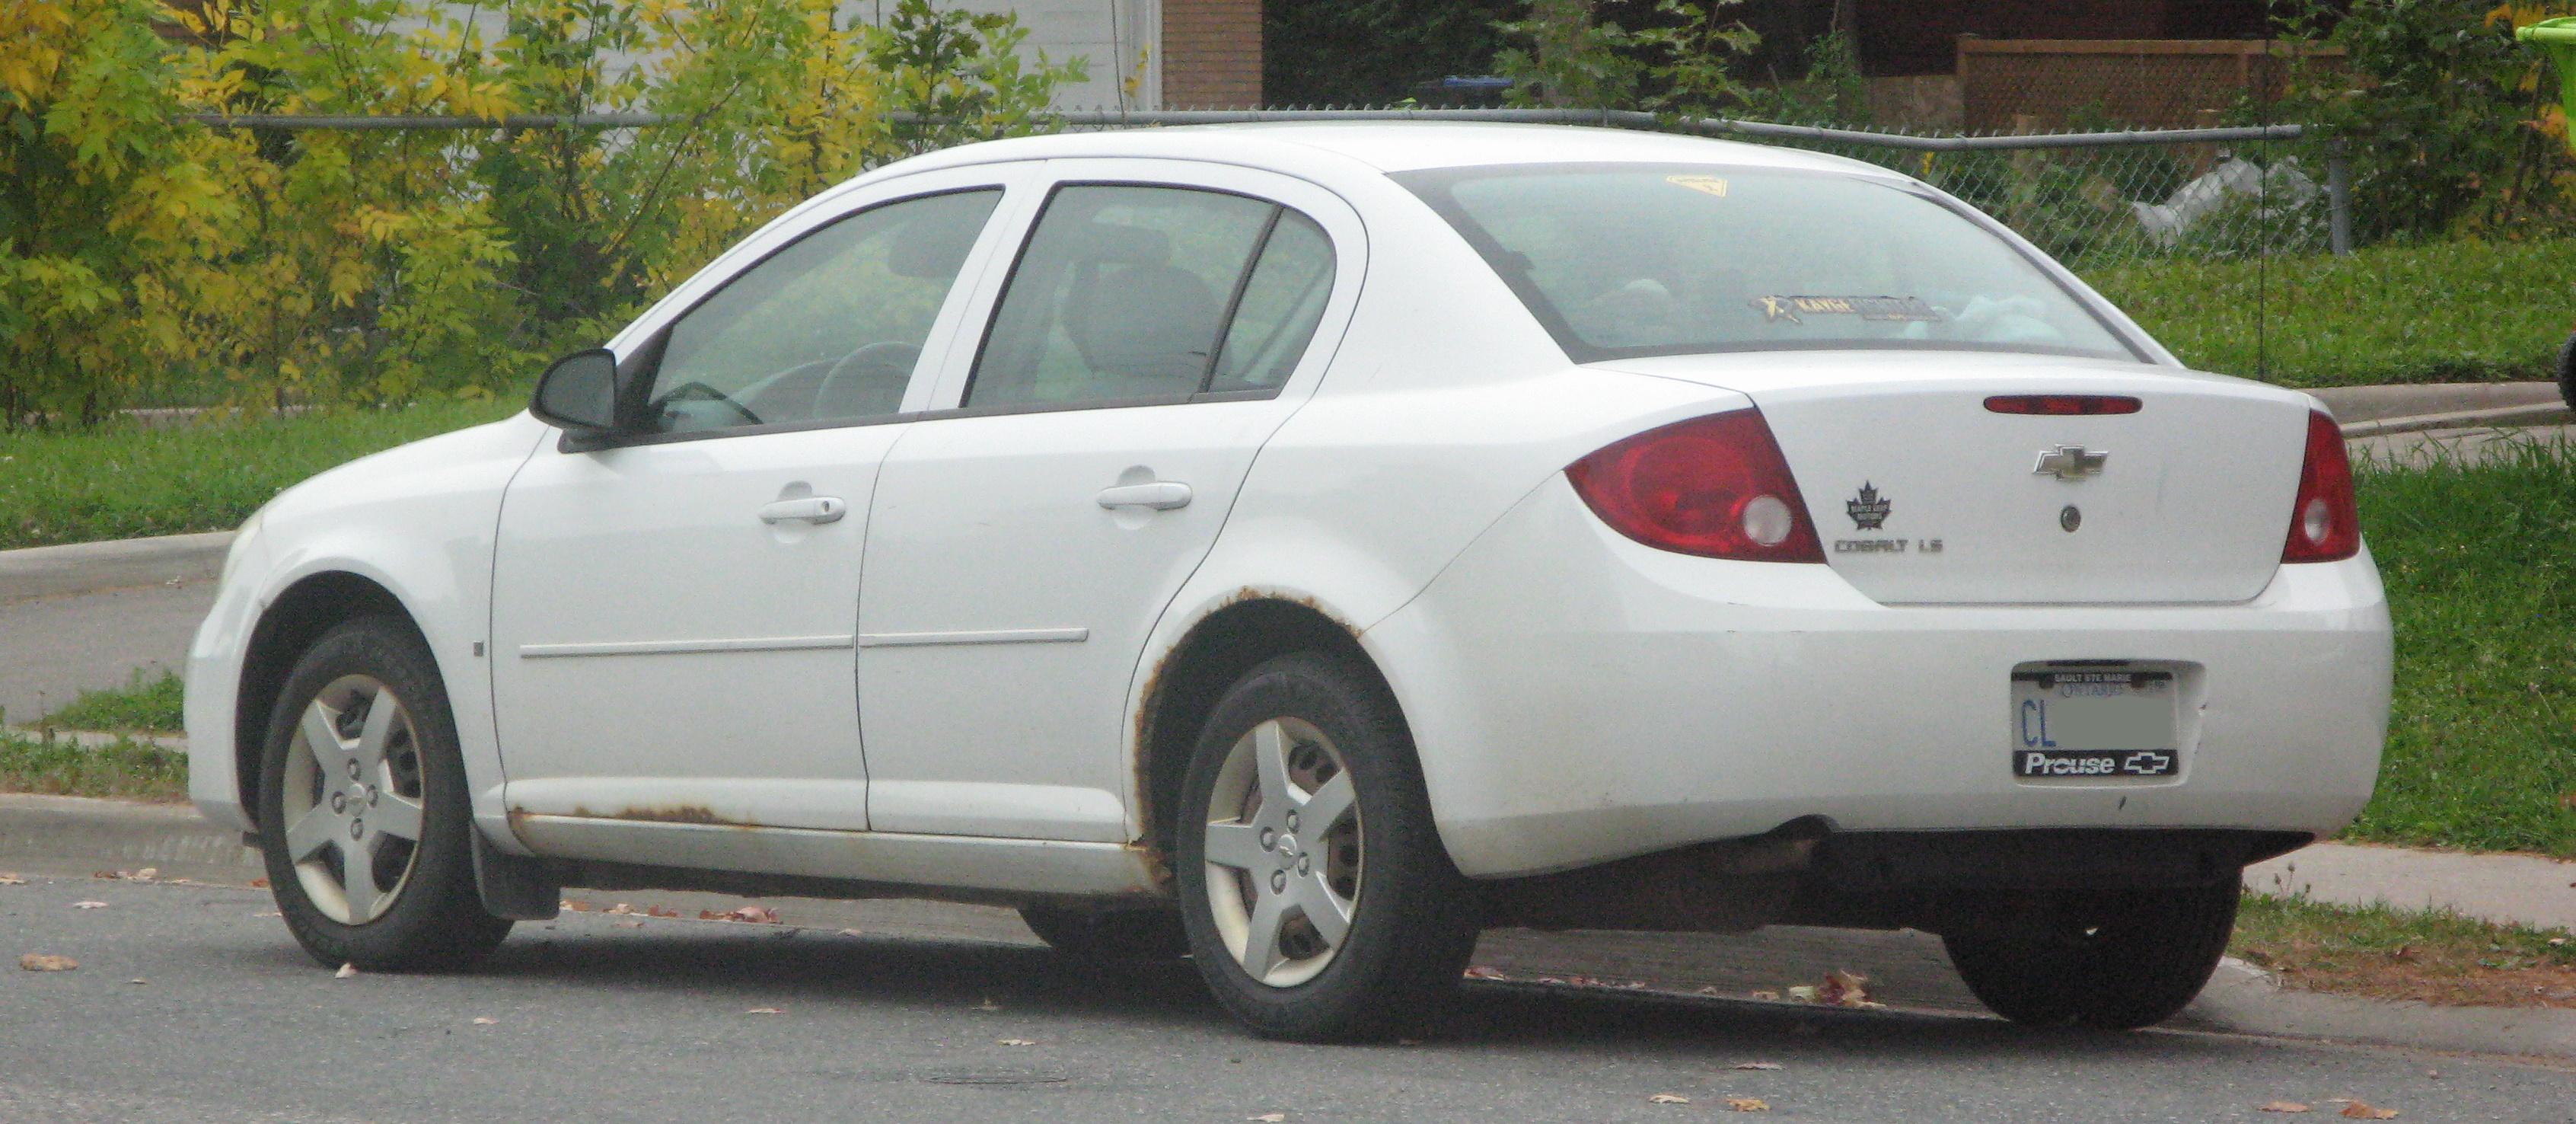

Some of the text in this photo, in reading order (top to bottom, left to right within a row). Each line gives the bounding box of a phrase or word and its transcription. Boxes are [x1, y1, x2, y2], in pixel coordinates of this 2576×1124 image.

[1835, 539, 1943, 552] COBALT LS
[2055, 673, 2082, 682] SAULT
[2103, 673, 2132, 682] MARIE
[2025, 752, 2115, 774] Prouse
